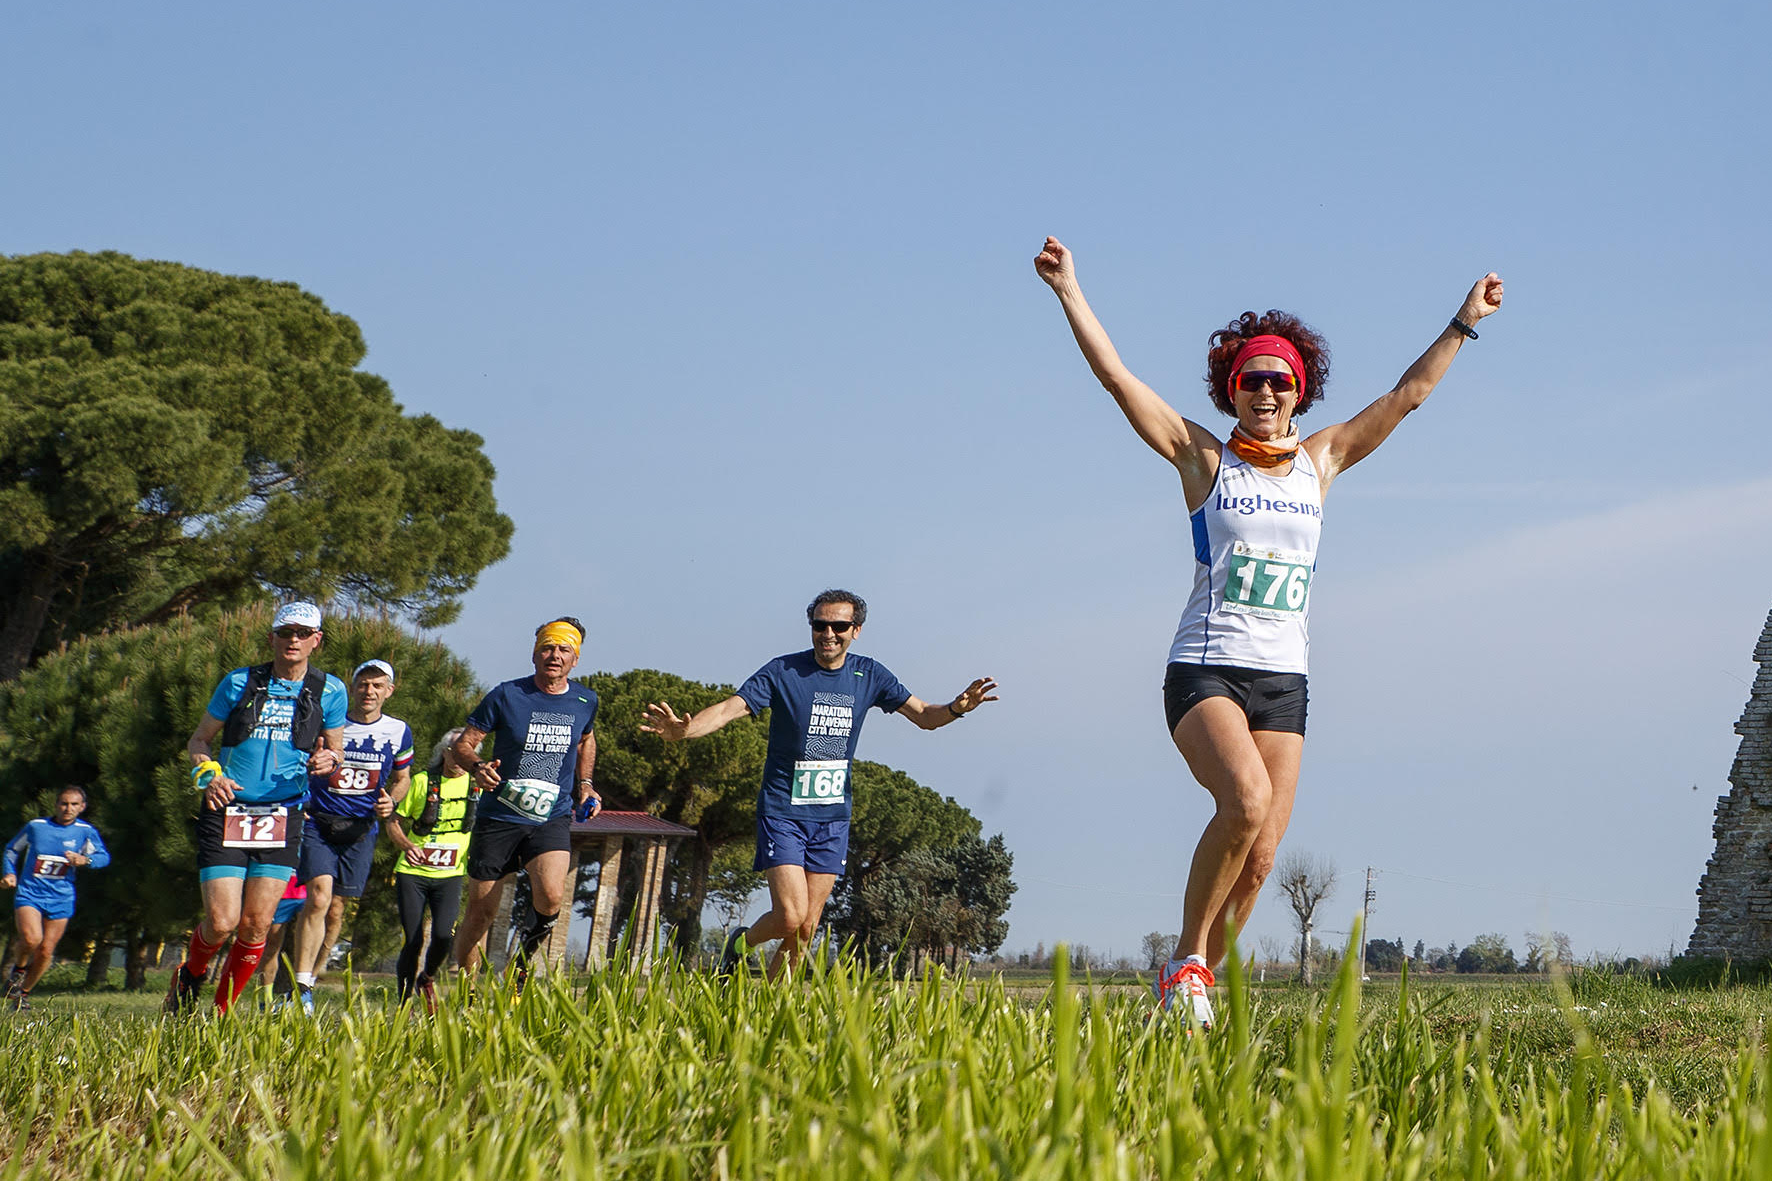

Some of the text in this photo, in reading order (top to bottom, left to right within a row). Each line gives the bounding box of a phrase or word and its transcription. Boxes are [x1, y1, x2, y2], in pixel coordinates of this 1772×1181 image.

[1236, 560, 1307, 609] 176
[811, 704, 853, 718] MARATONA
[528, 723, 571, 735] MARATONA
[810, 715, 853, 729] DI RAVENNA
[526, 733, 571, 746] DI RAVENNA
[338, 768, 369, 789] 38
[798, 770, 845, 797] 168
[508, 785, 554, 815] 166
[239, 815, 275, 841] 12
[428, 849, 453, 865] 44
[40, 860, 64, 875] 57
